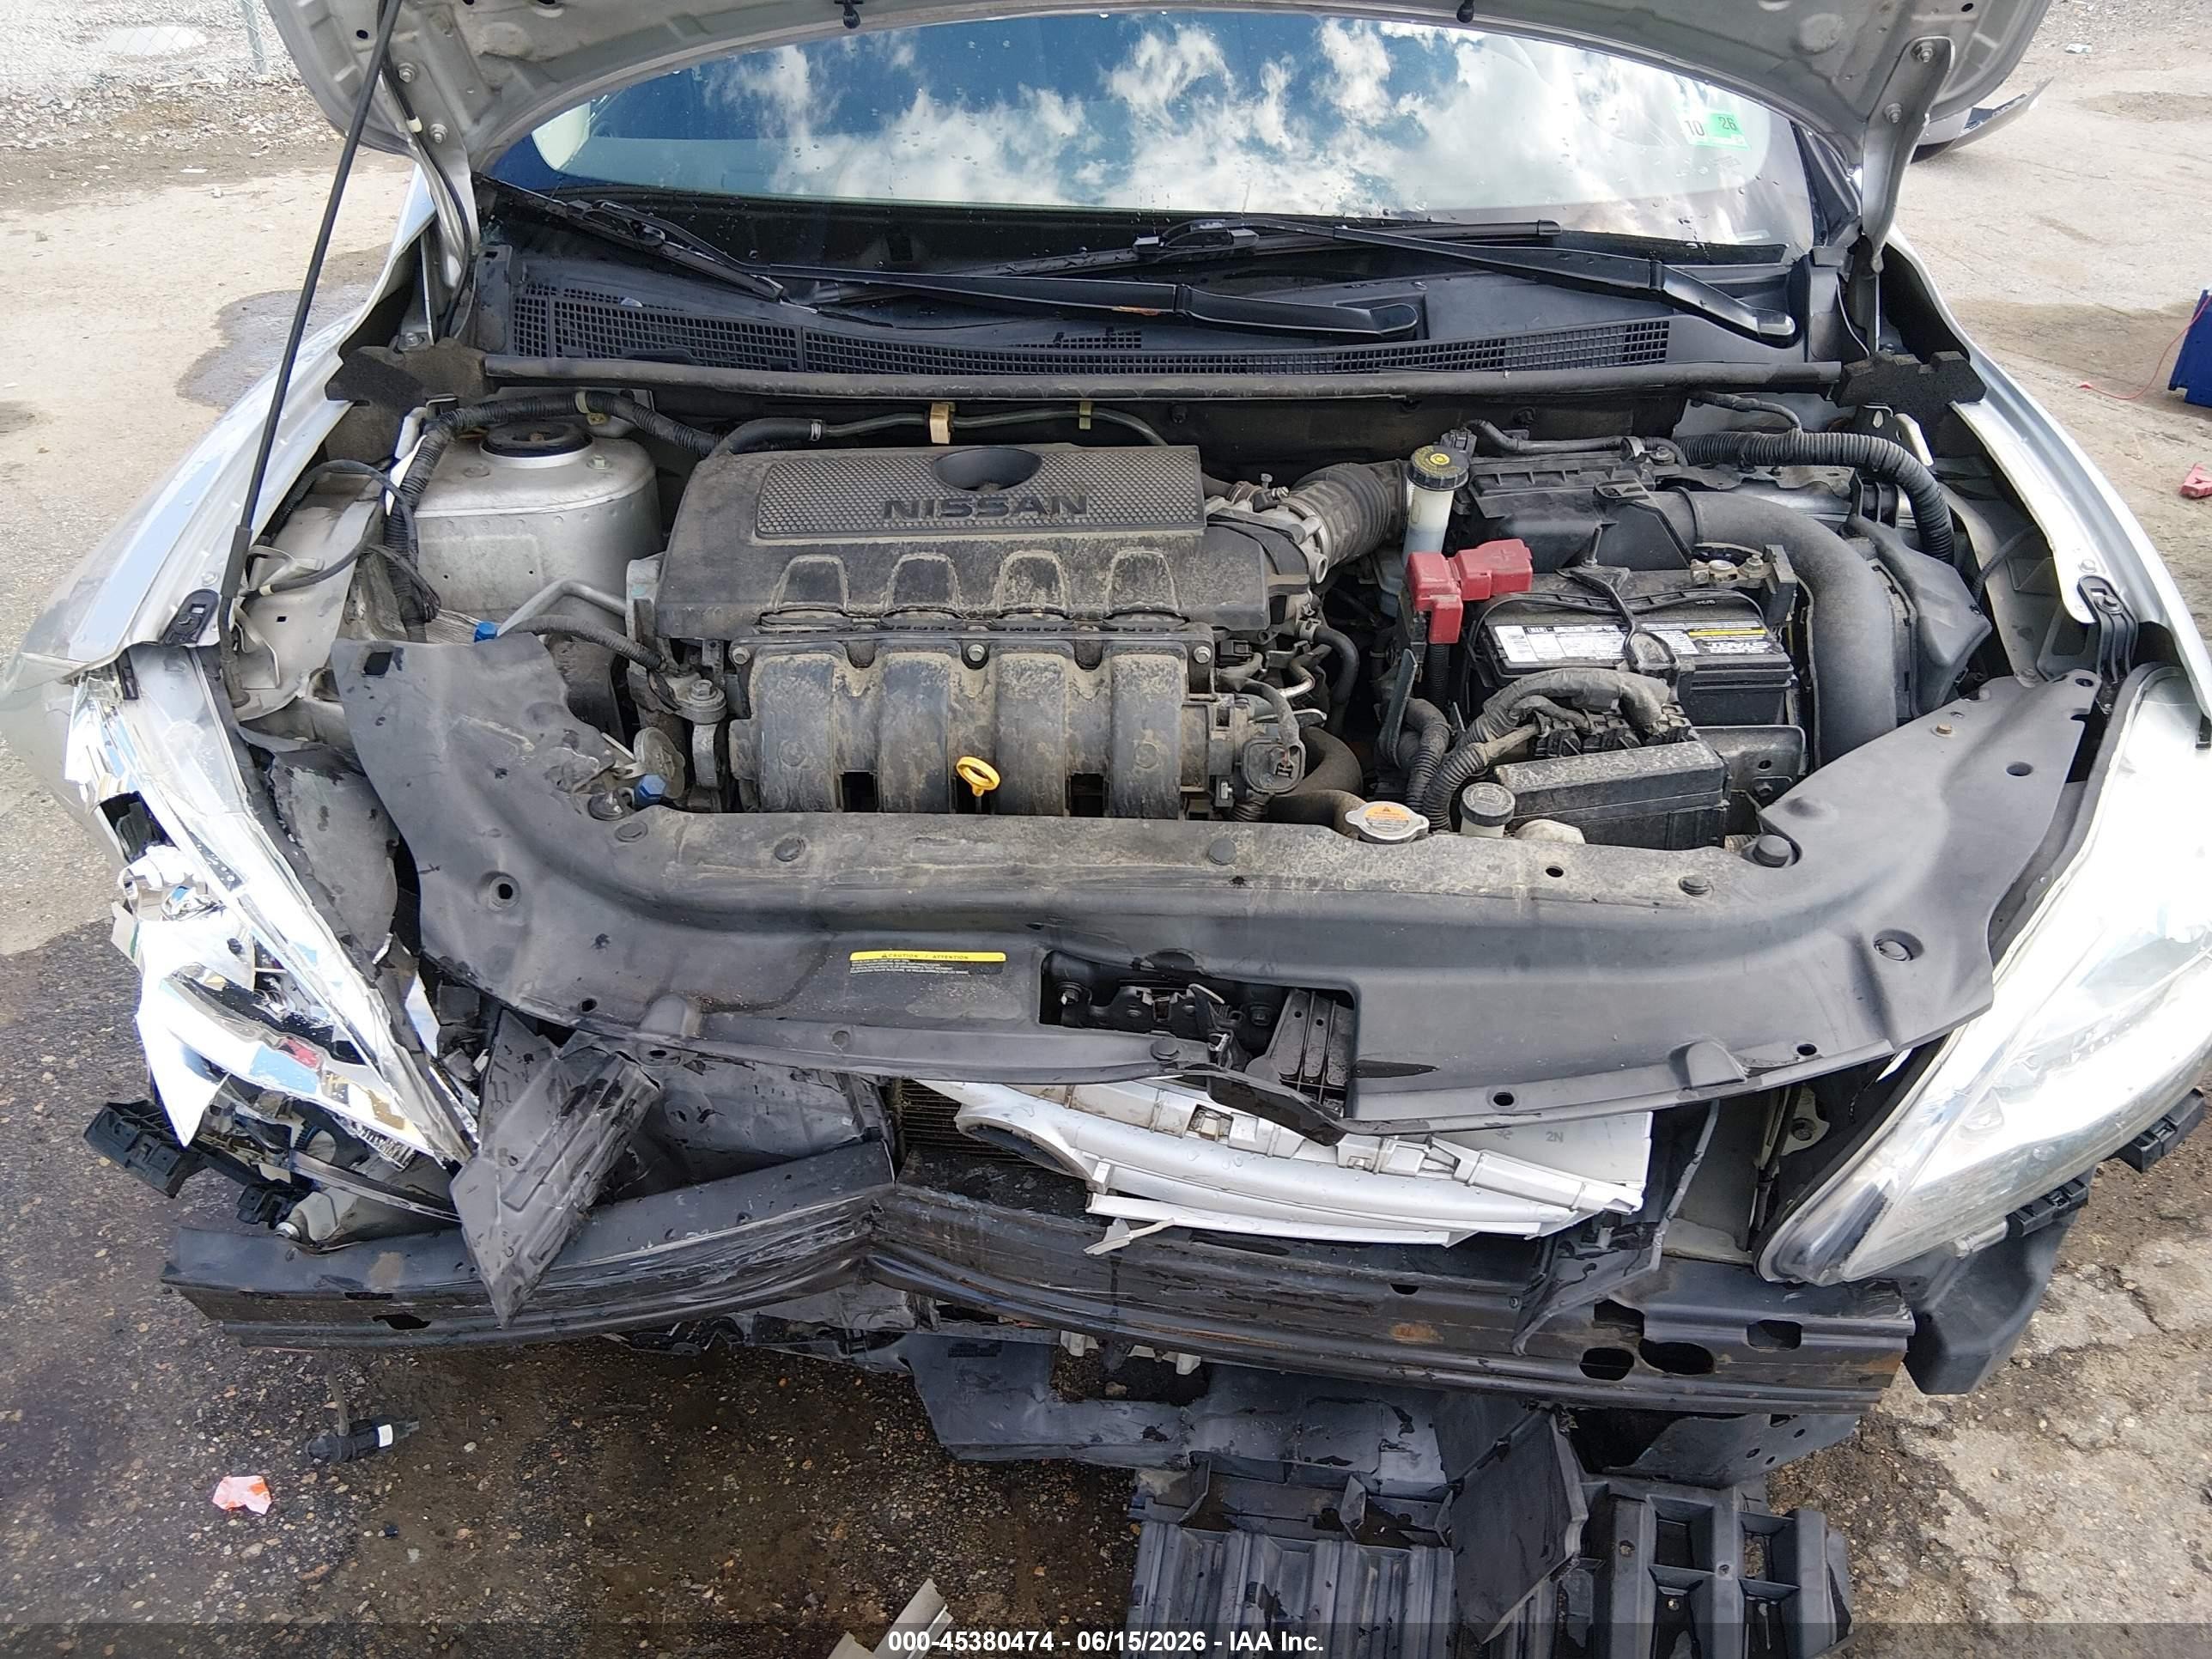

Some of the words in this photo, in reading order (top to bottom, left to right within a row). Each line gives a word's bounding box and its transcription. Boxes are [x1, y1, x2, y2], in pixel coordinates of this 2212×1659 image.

[1684, 119, 1705, 137] 10
[1718, 116, 1738, 131] 26
[883, 495, 1088, 520] NISSAN
[1546, 1131, 1564, 1142] 2N
